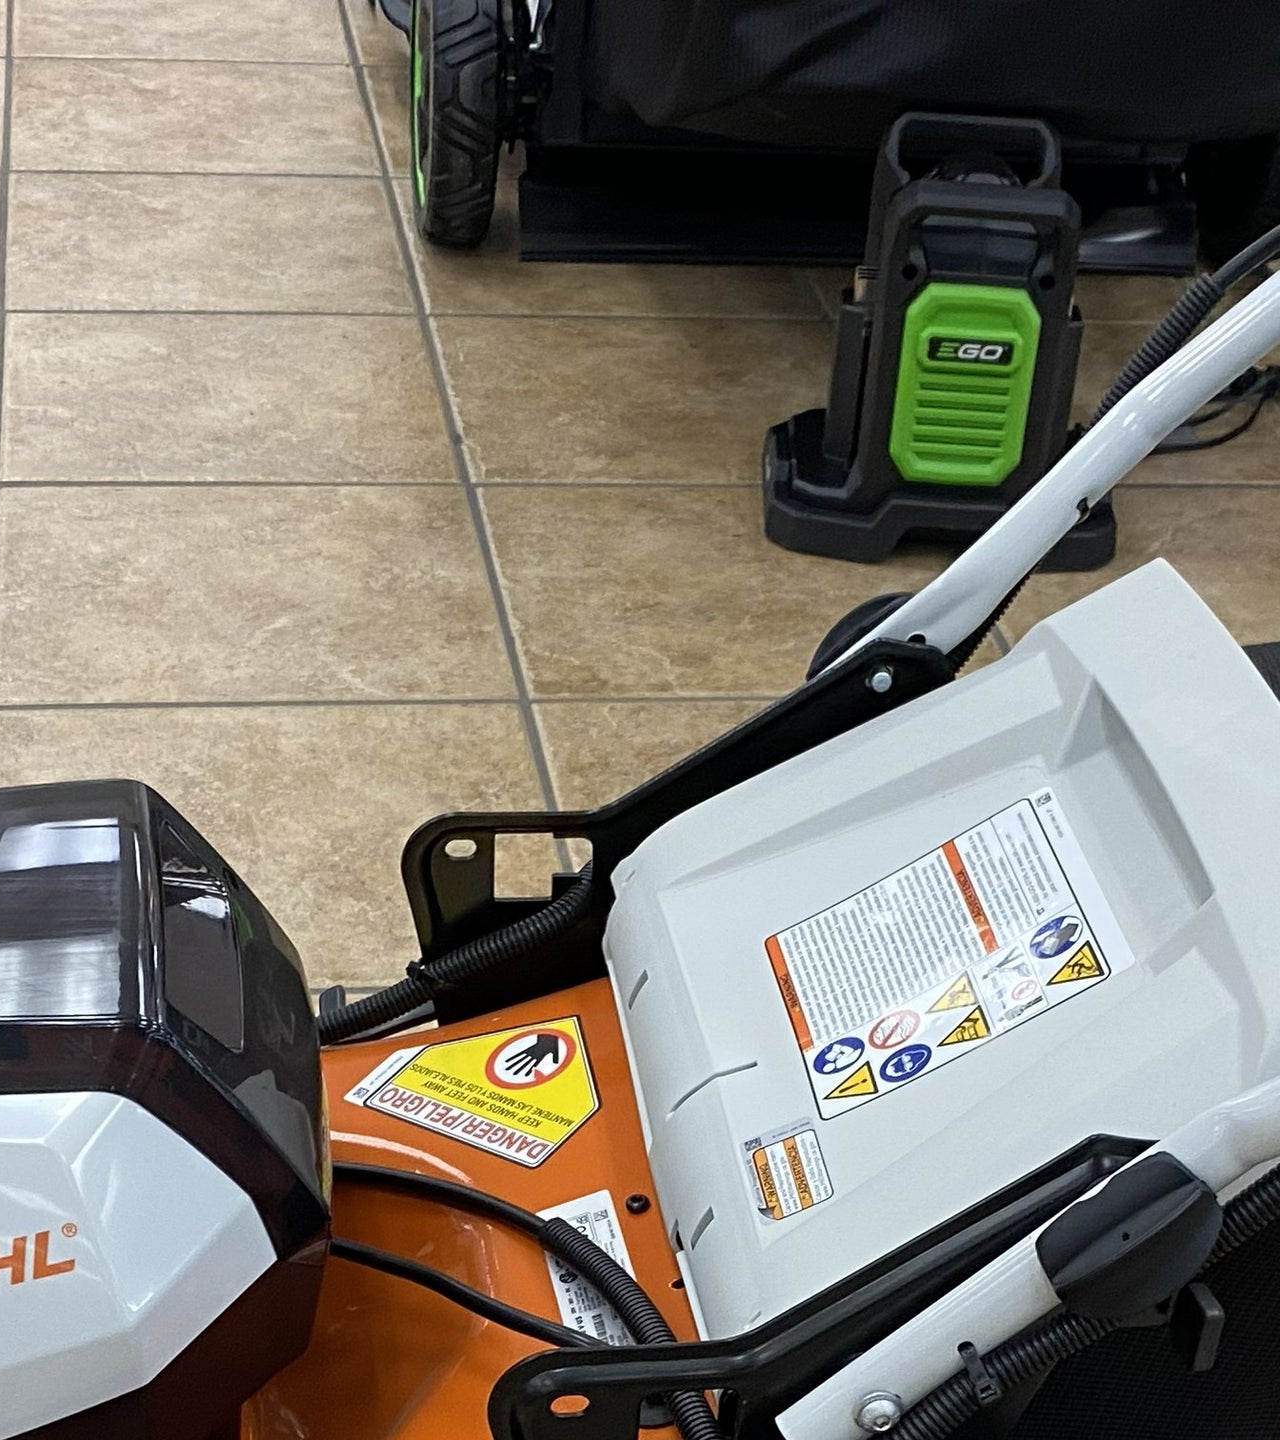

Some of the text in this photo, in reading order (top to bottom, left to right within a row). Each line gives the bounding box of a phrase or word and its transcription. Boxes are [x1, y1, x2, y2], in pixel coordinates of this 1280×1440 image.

[937, 342, 1004, 360] EGO
[378, 1087, 550, 1159] DANGER/PELIGRO
[421, 1079, 542, 1128] KEEP HANDS AND FEET AWAY
